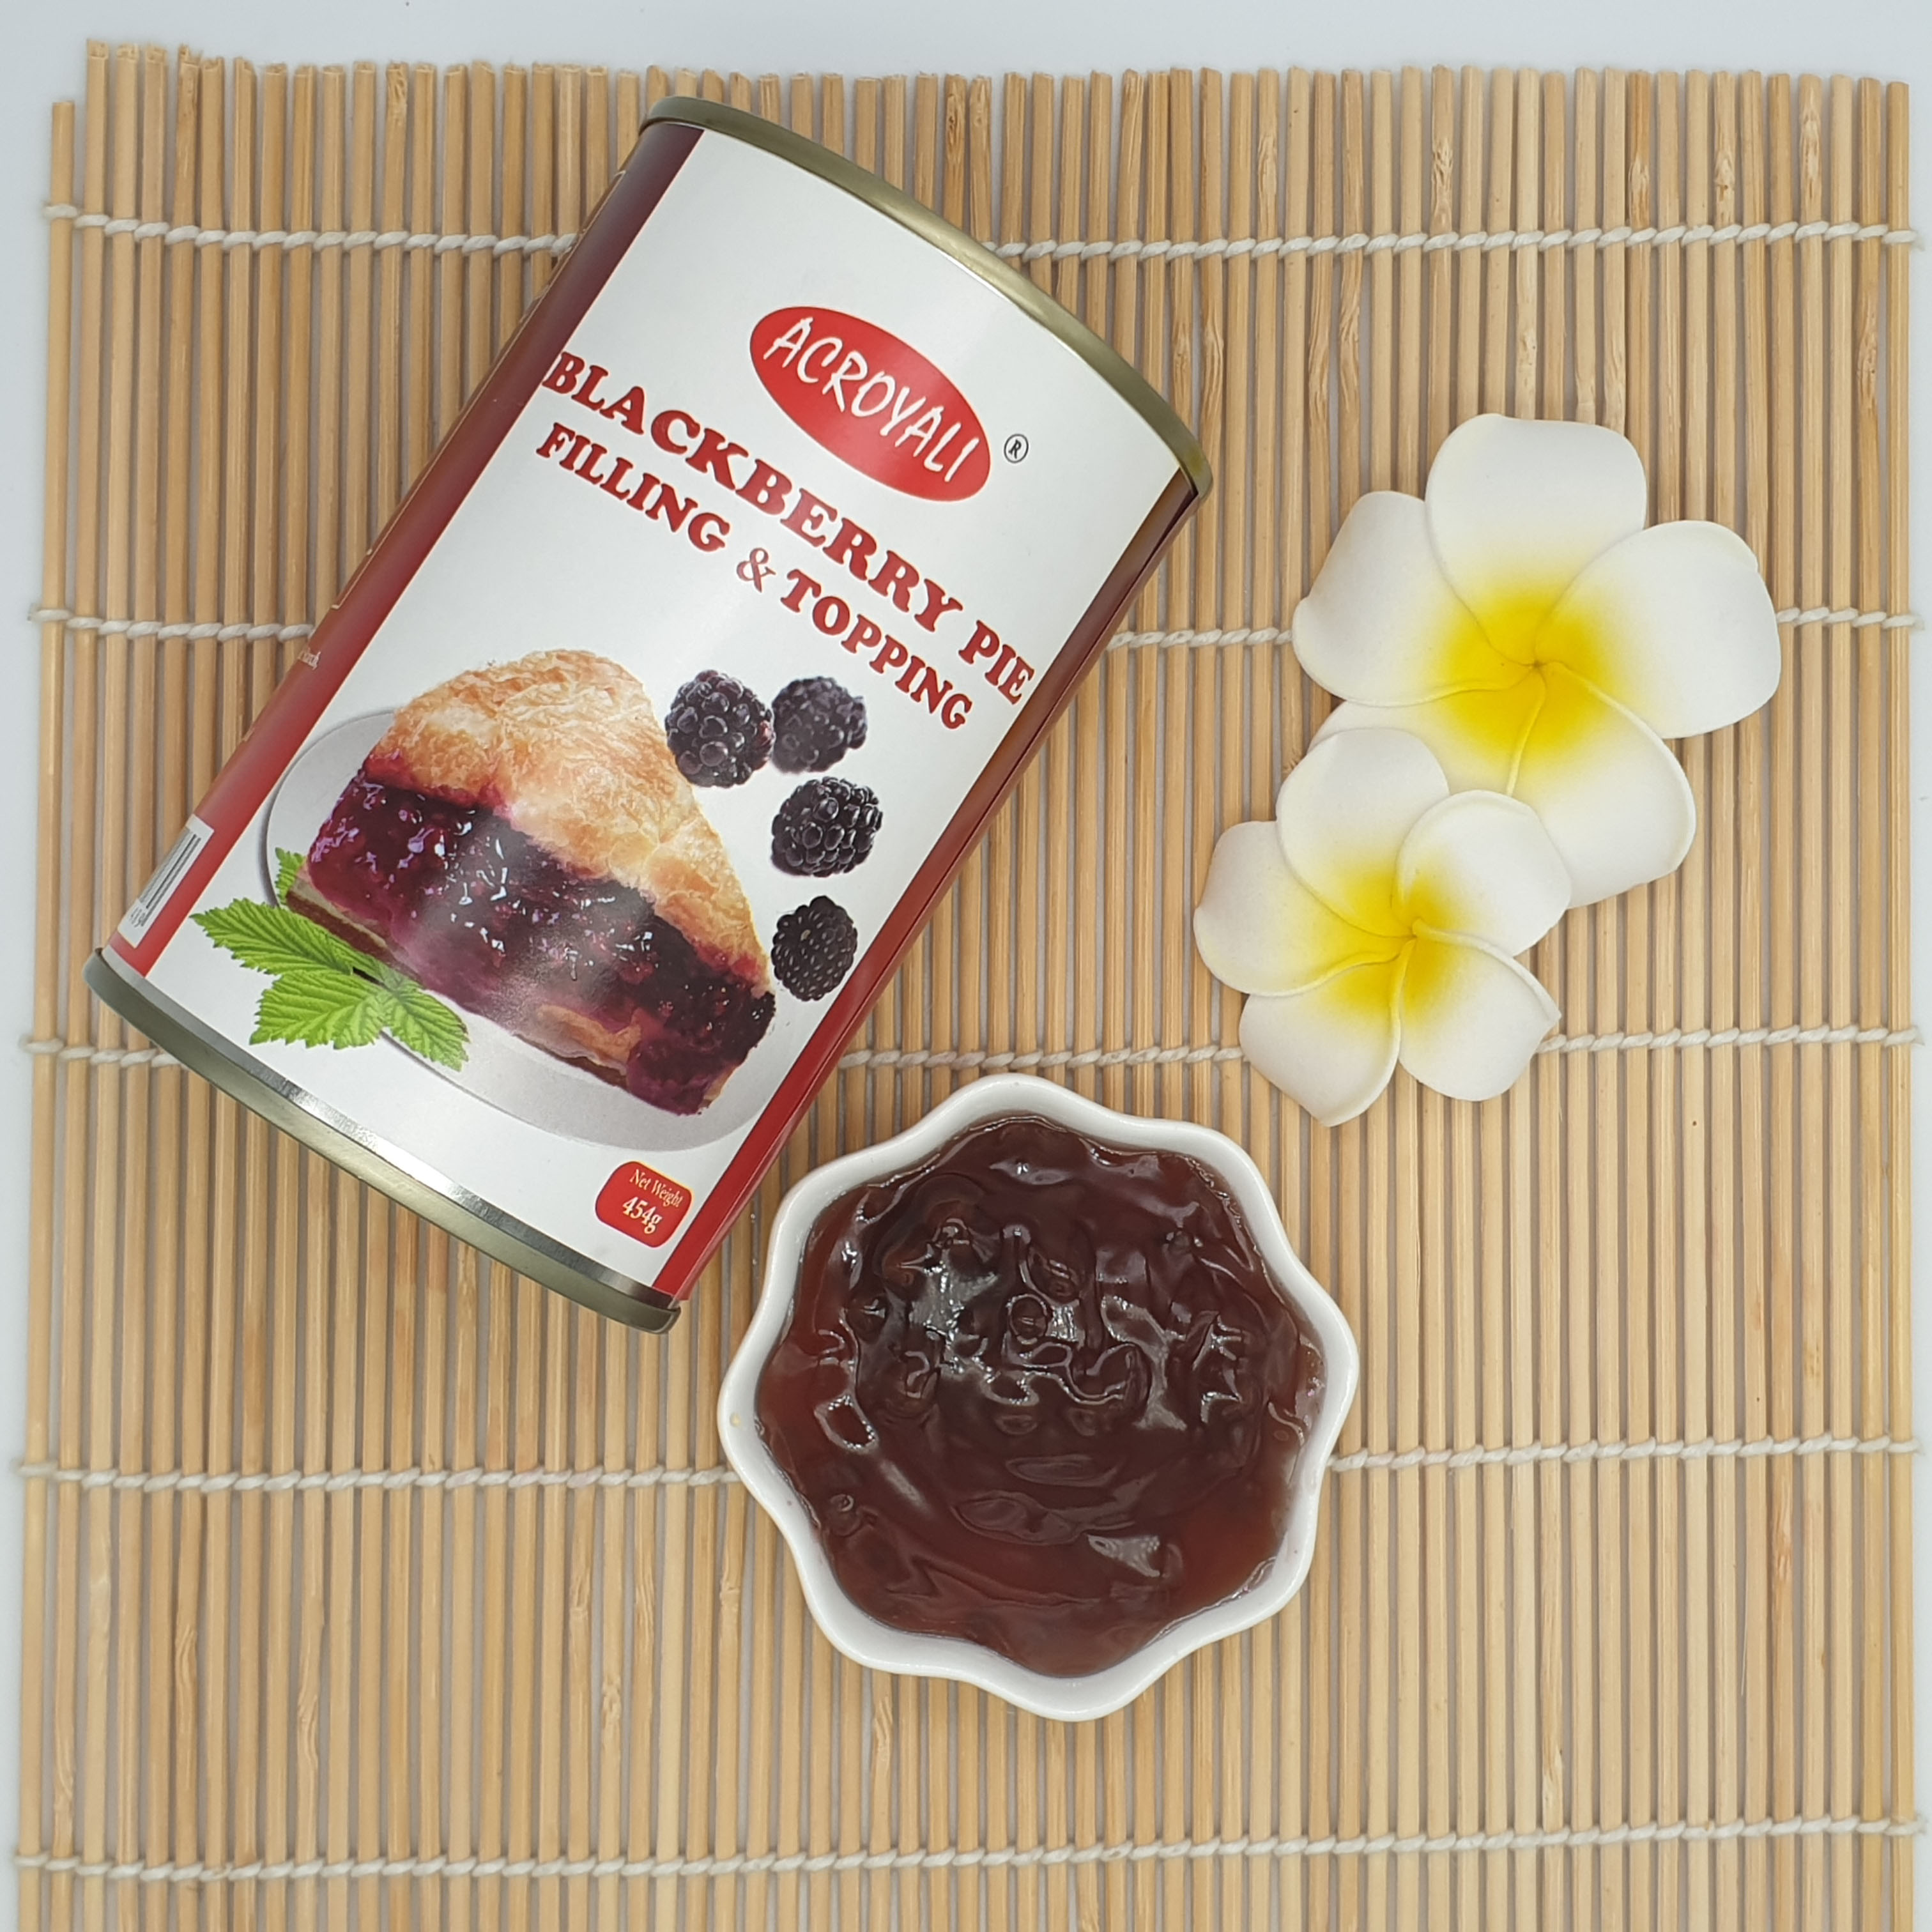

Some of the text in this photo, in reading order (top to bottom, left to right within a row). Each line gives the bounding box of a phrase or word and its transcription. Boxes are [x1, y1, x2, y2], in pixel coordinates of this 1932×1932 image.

[763, 317, 979, 482] ACROYALI
[535, 422, 972, 730] FILLING & TOPPING
[542, 351, 1035, 705] BLACKBERRY PIE
[622, 1197, 663, 1234] 454g
[629, 1169, 683, 1207] Net Weight
